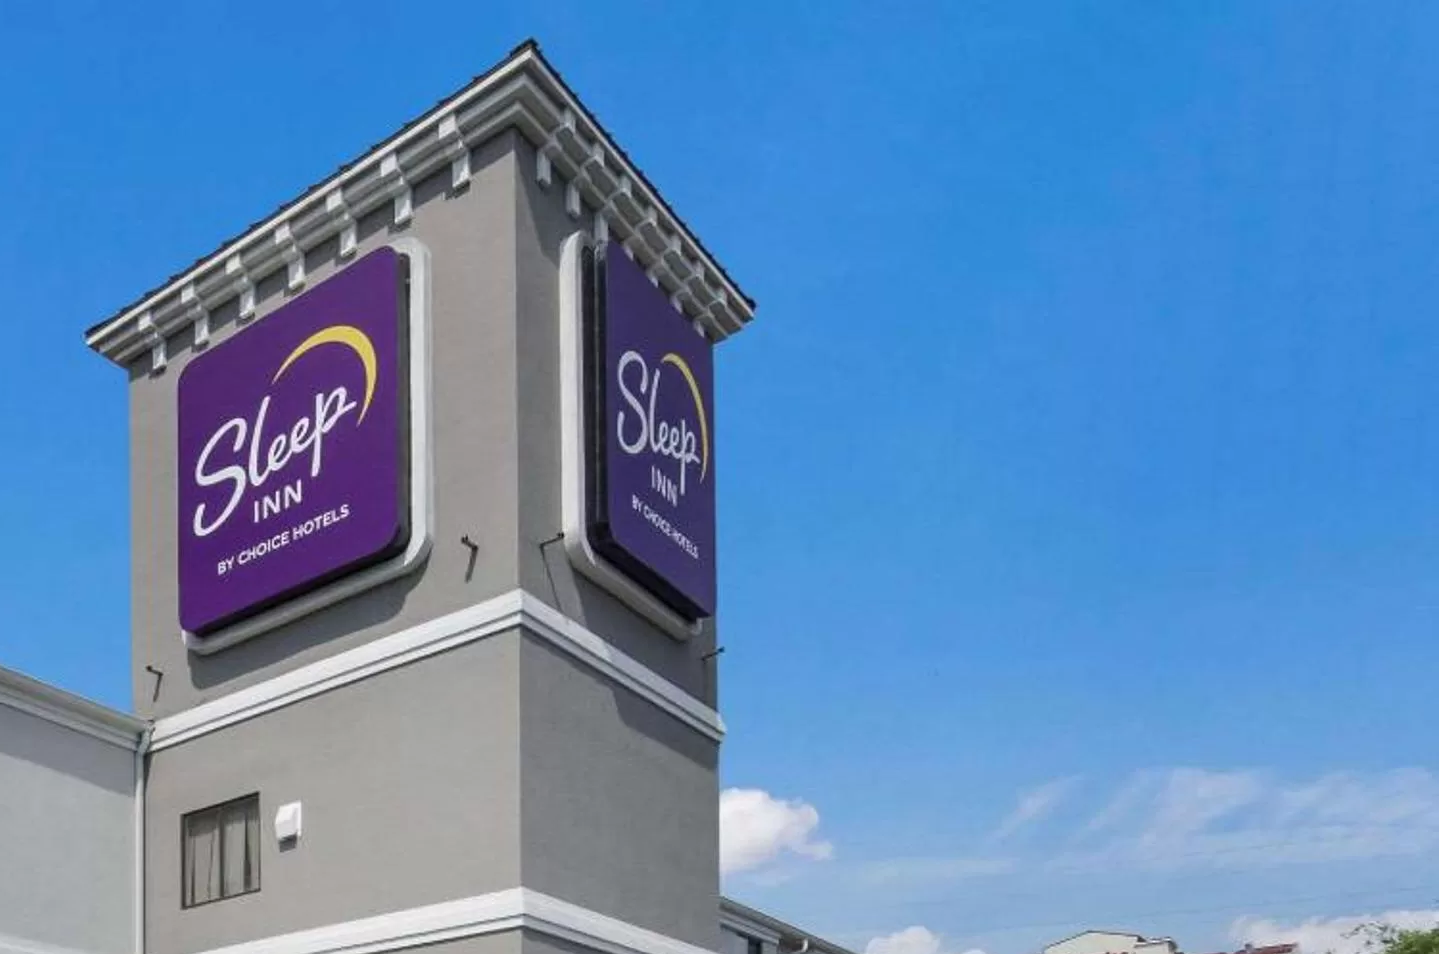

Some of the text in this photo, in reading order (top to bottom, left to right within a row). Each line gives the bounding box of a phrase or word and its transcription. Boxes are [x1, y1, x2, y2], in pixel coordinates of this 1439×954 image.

[618, 351, 700, 495] Sleep
[194, 386, 357, 537] Sleep
[651, 464, 678, 507] INN
[253, 479, 303, 524] INN
[632, 494, 699, 559] BY CHOICE HOTELS
[217, 503, 350, 575] BY CHOICE HOTELS
